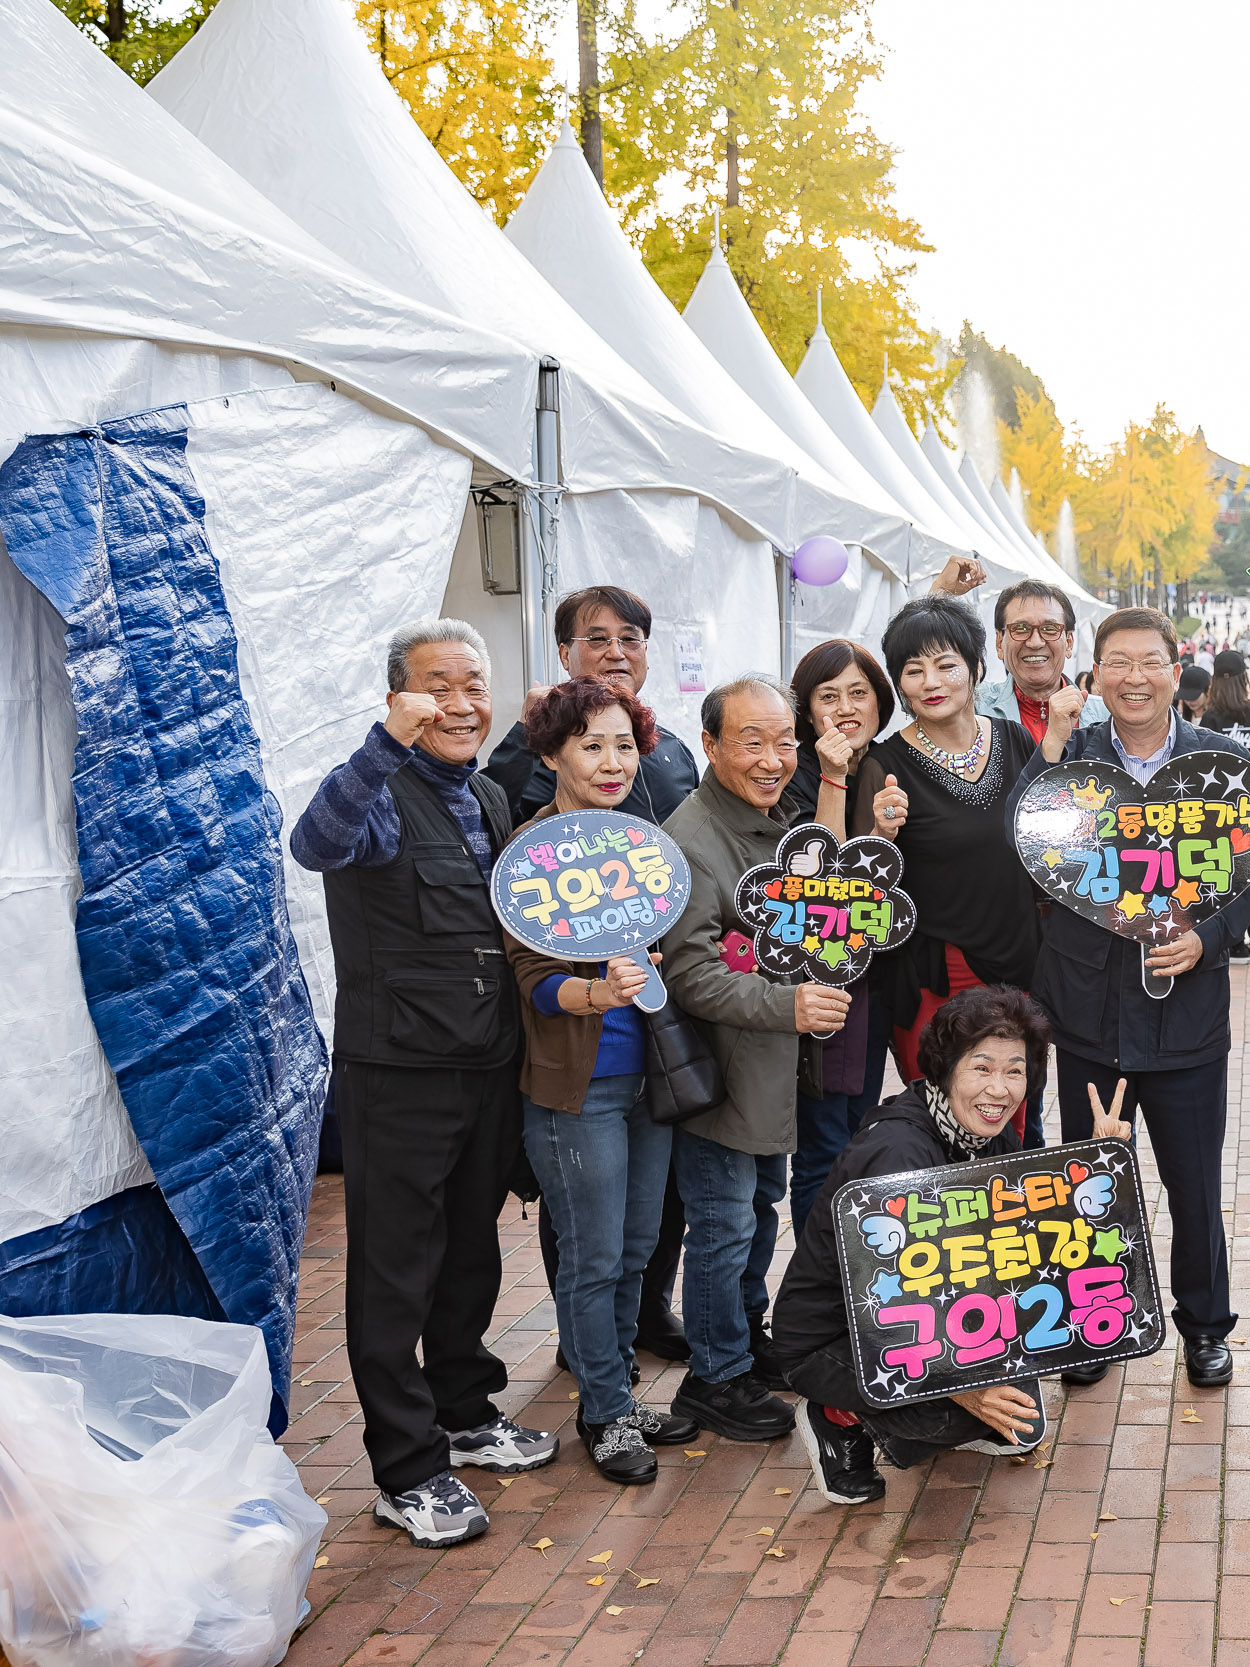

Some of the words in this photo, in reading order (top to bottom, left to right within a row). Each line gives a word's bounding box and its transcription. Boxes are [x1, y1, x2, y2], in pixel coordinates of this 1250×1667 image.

[526, 827, 631, 873] 빛이나는
[1063, 836, 1232, 903] 김기덕
[510, 845, 674, 926] 구의2동
[782, 876, 873, 901] 폼미쳤다
[568, 896, 655, 941] 파이팅
[764, 899, 892, 943] 김기덕
[907, 1175, 1072, 1239] 슈퍼스타
[898, 1217, 1093, 1297] 우주최강
[877, 1265, 1133, 1378] 구의2동
